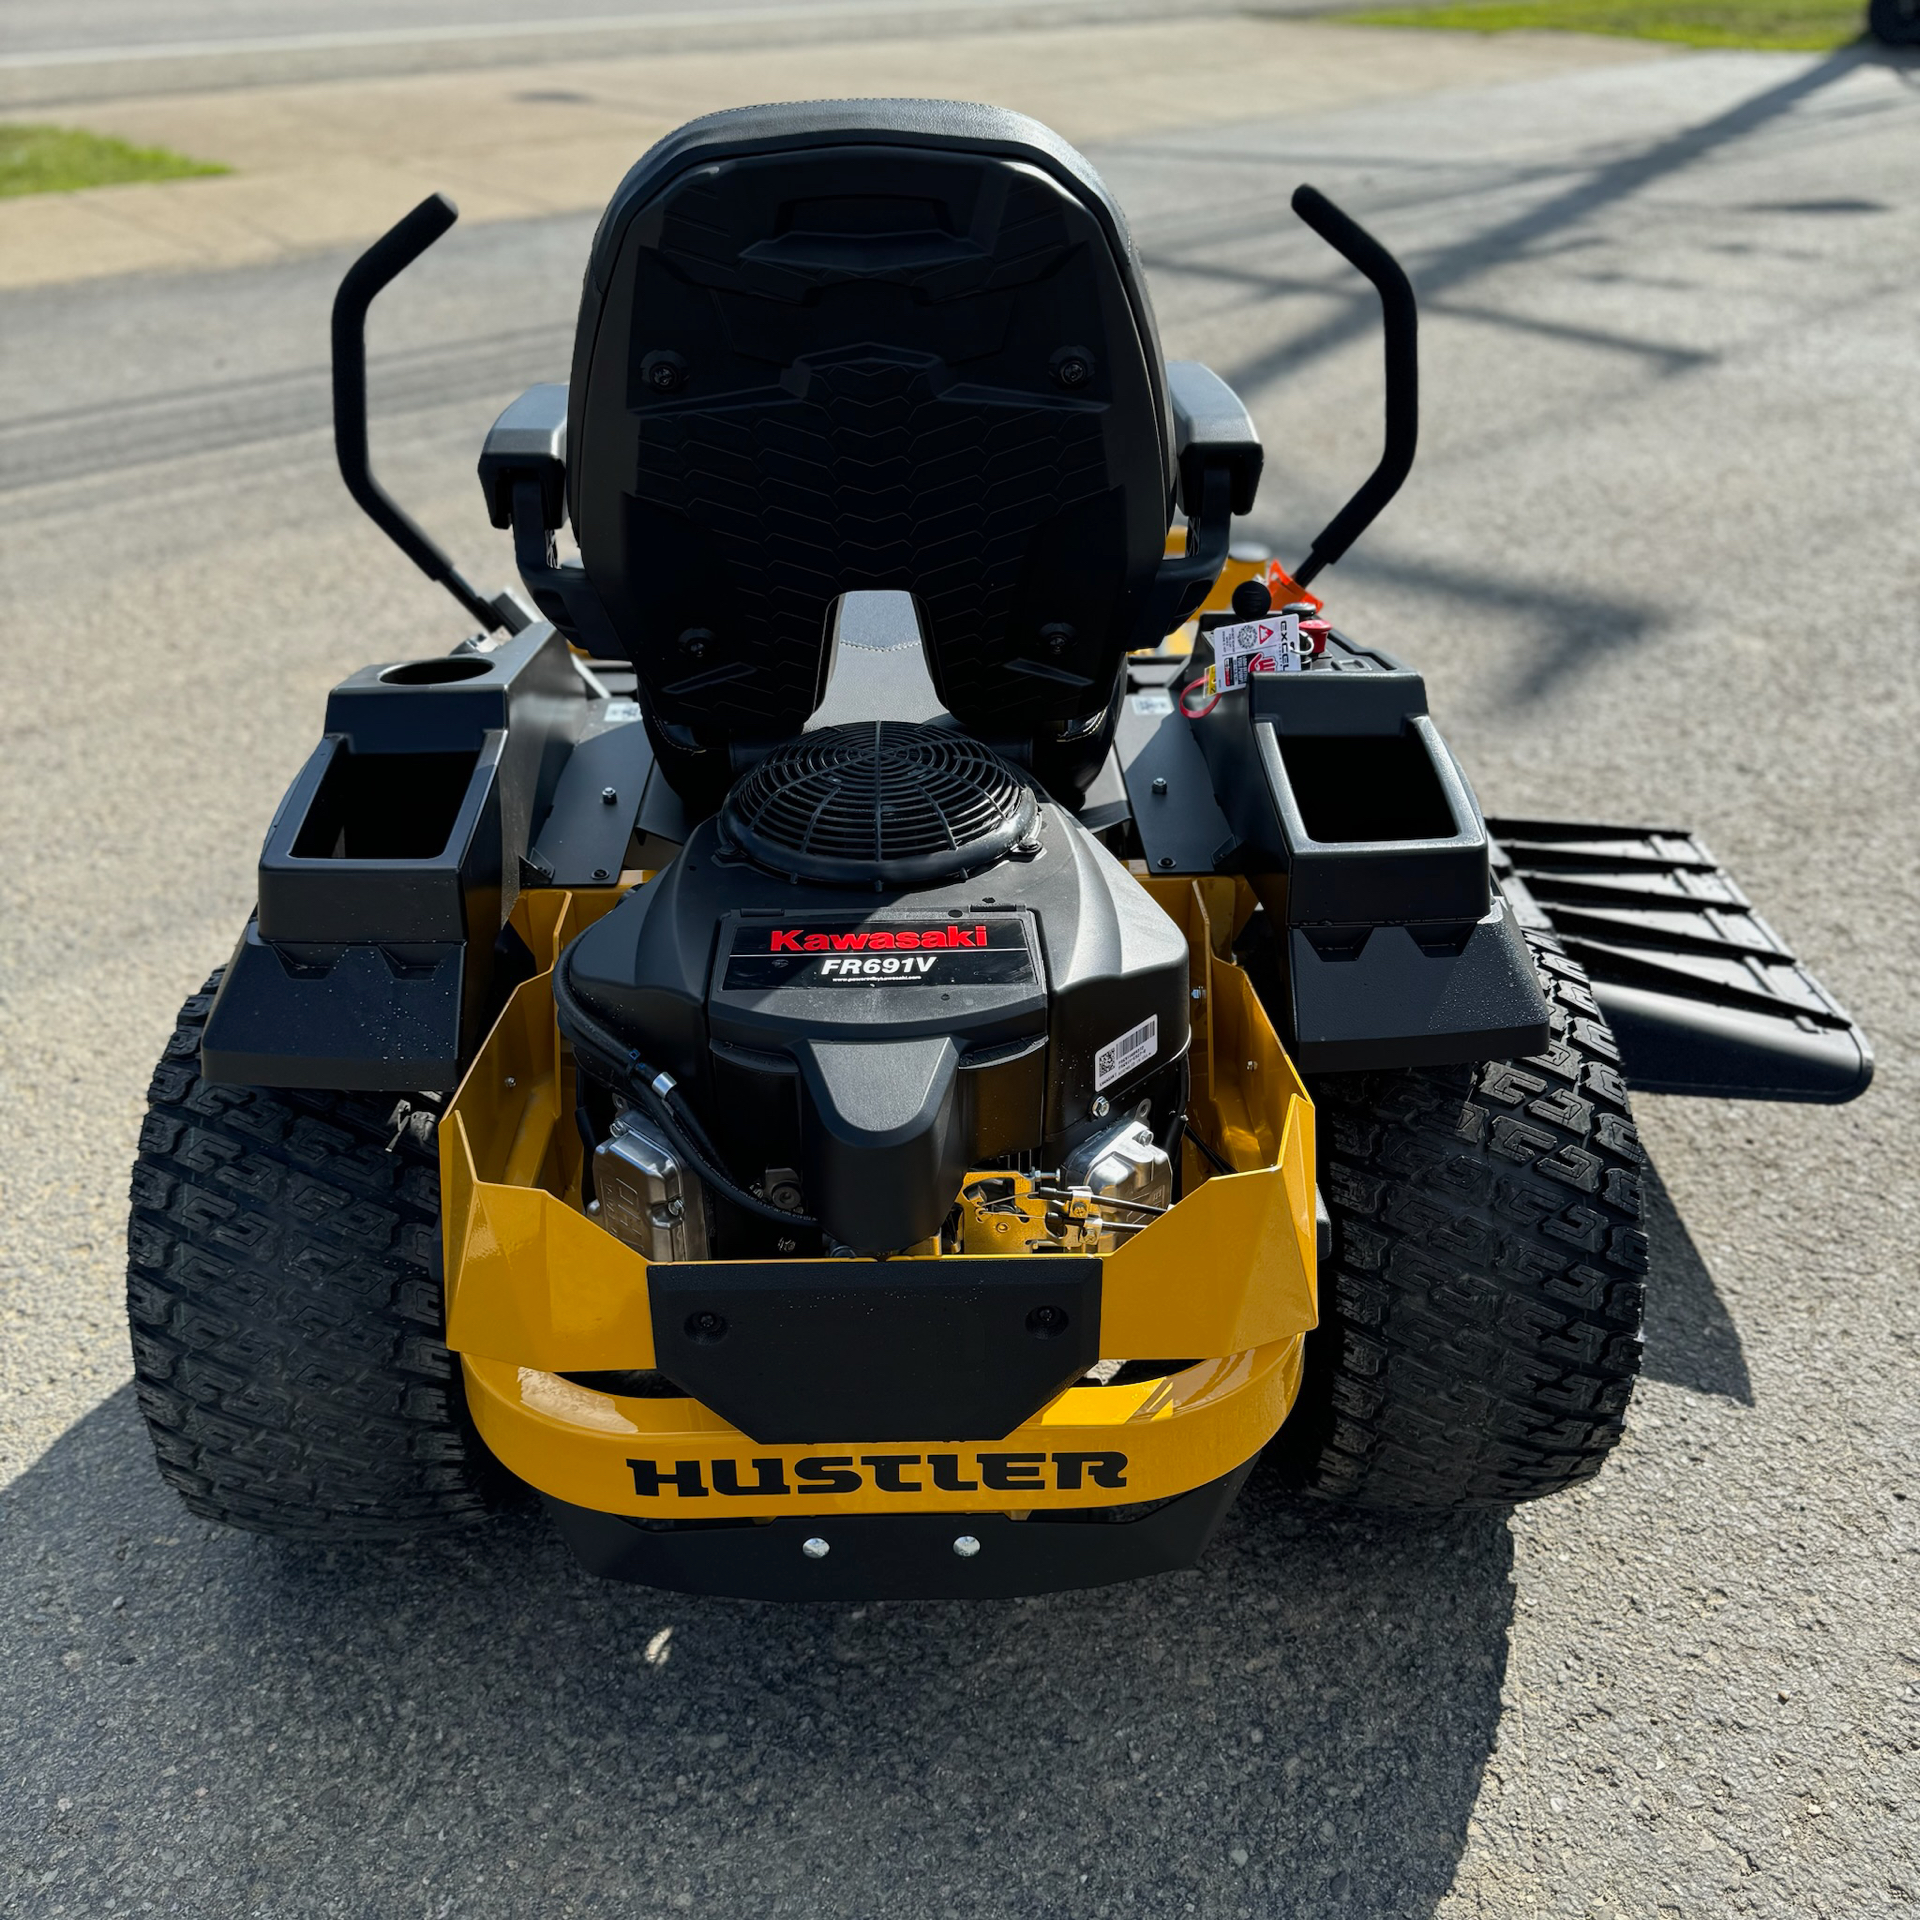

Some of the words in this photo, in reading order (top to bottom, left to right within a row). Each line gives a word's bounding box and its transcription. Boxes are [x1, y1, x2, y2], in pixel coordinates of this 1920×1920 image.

[770, 925, 988, 951] Kawasaki
[821, 956, 937, 976] FR691V
[626, 1451, 1129, 1498] HUSTLER
